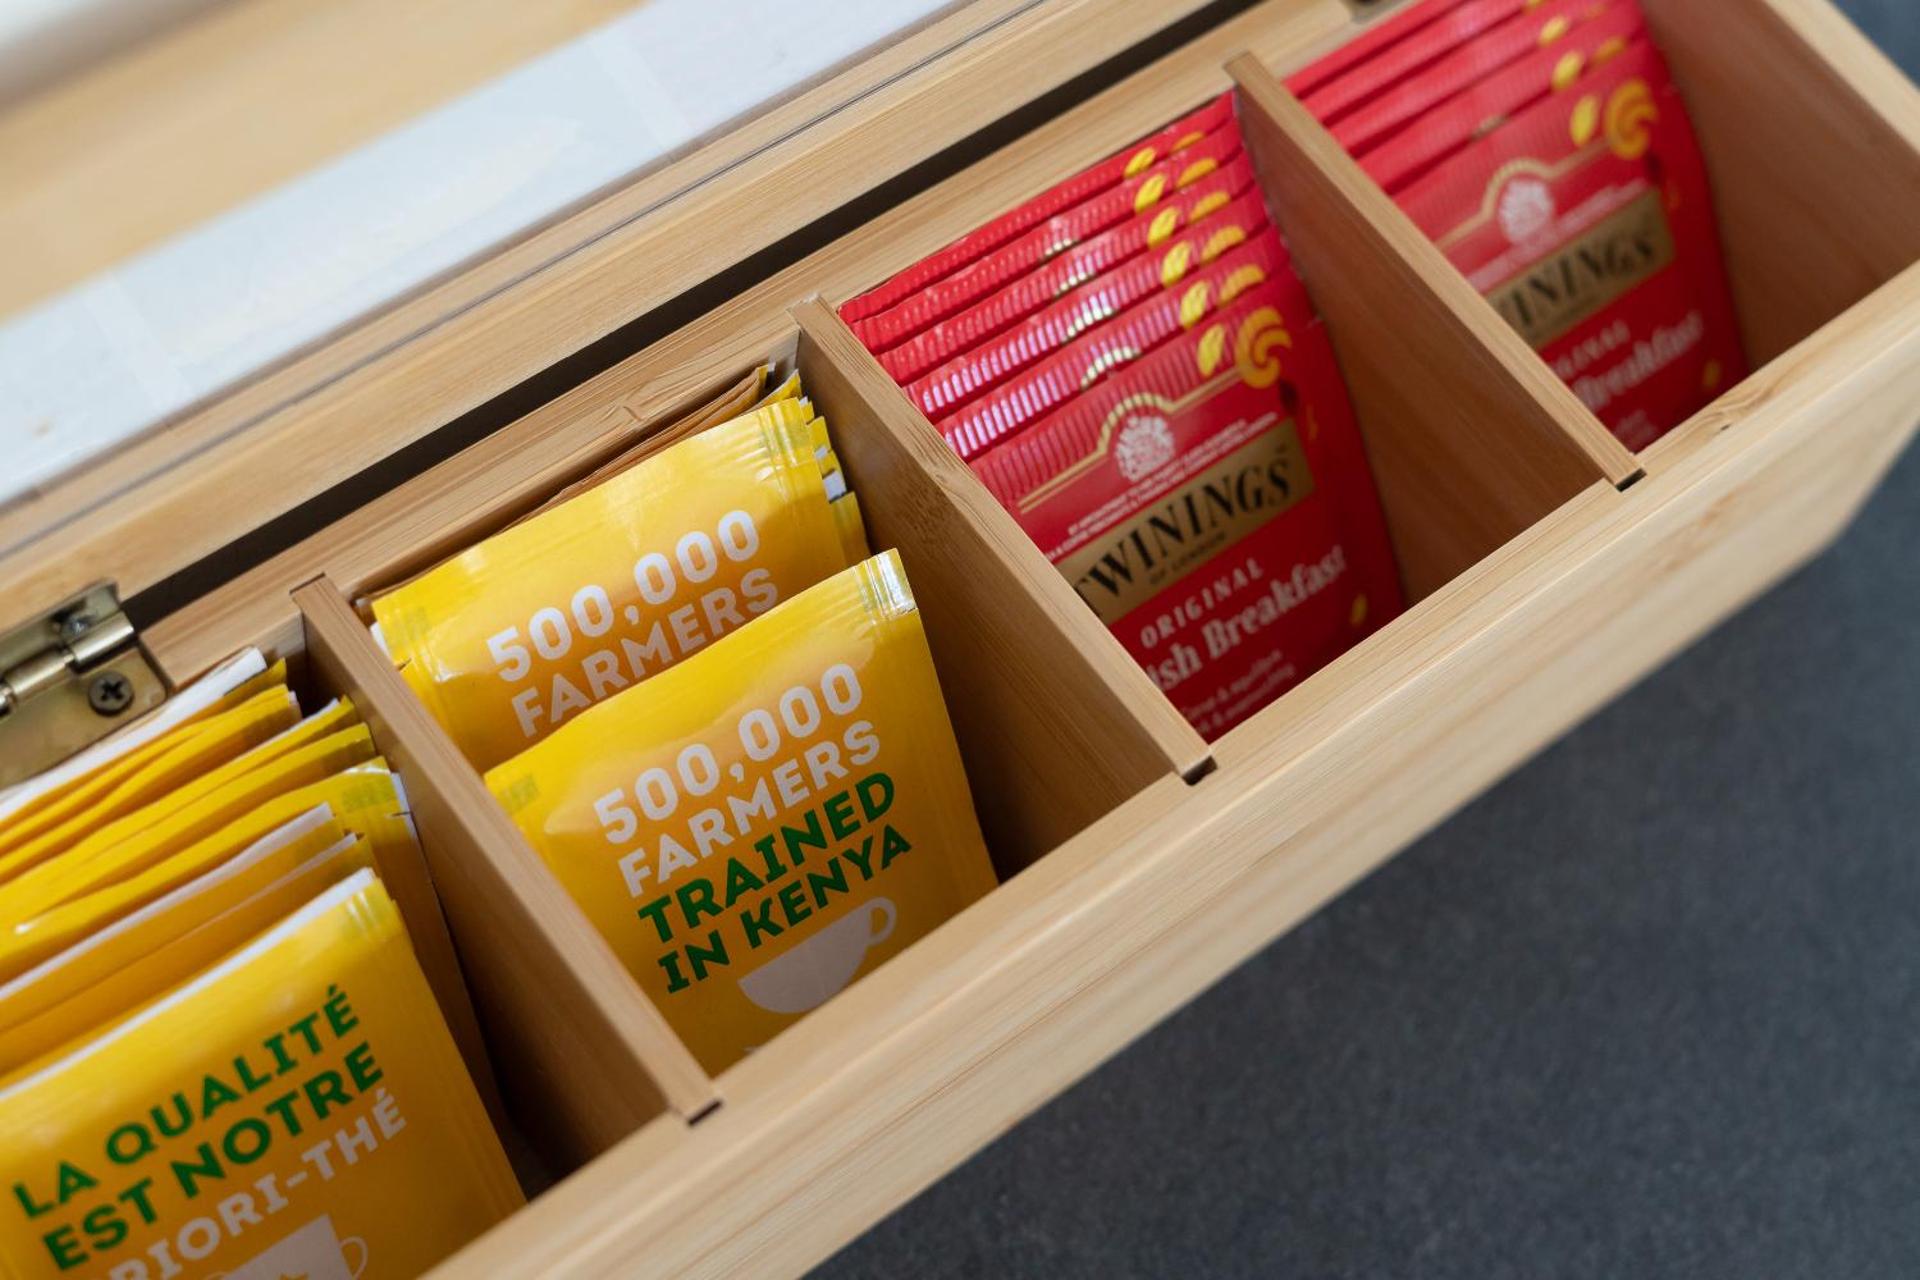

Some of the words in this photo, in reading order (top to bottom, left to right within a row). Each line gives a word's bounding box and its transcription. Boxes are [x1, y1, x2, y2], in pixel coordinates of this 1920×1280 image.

[487, 509, 760, 682] 500,000
[511, 567, 779, 738] FARMERS
[1140, 557, 1264, 648] ORIGINAL
[1202, 544, 1347, 660] Breakfast
[593, 663, 863, 845] 500,000
[618, 720, 881, 897] FARMERS
[638, 771, 896, 943] TRAINED
[657, 935, 730, 994] IN
[740, 823, 912, 949] KENYA
[13, 1160, 98, 1219] LA
[106, 983, 360, 1165] QUALITÉ
[42, 1177, 158, 1271] EST
[170, 1041, 385, 1198] NOTRE
